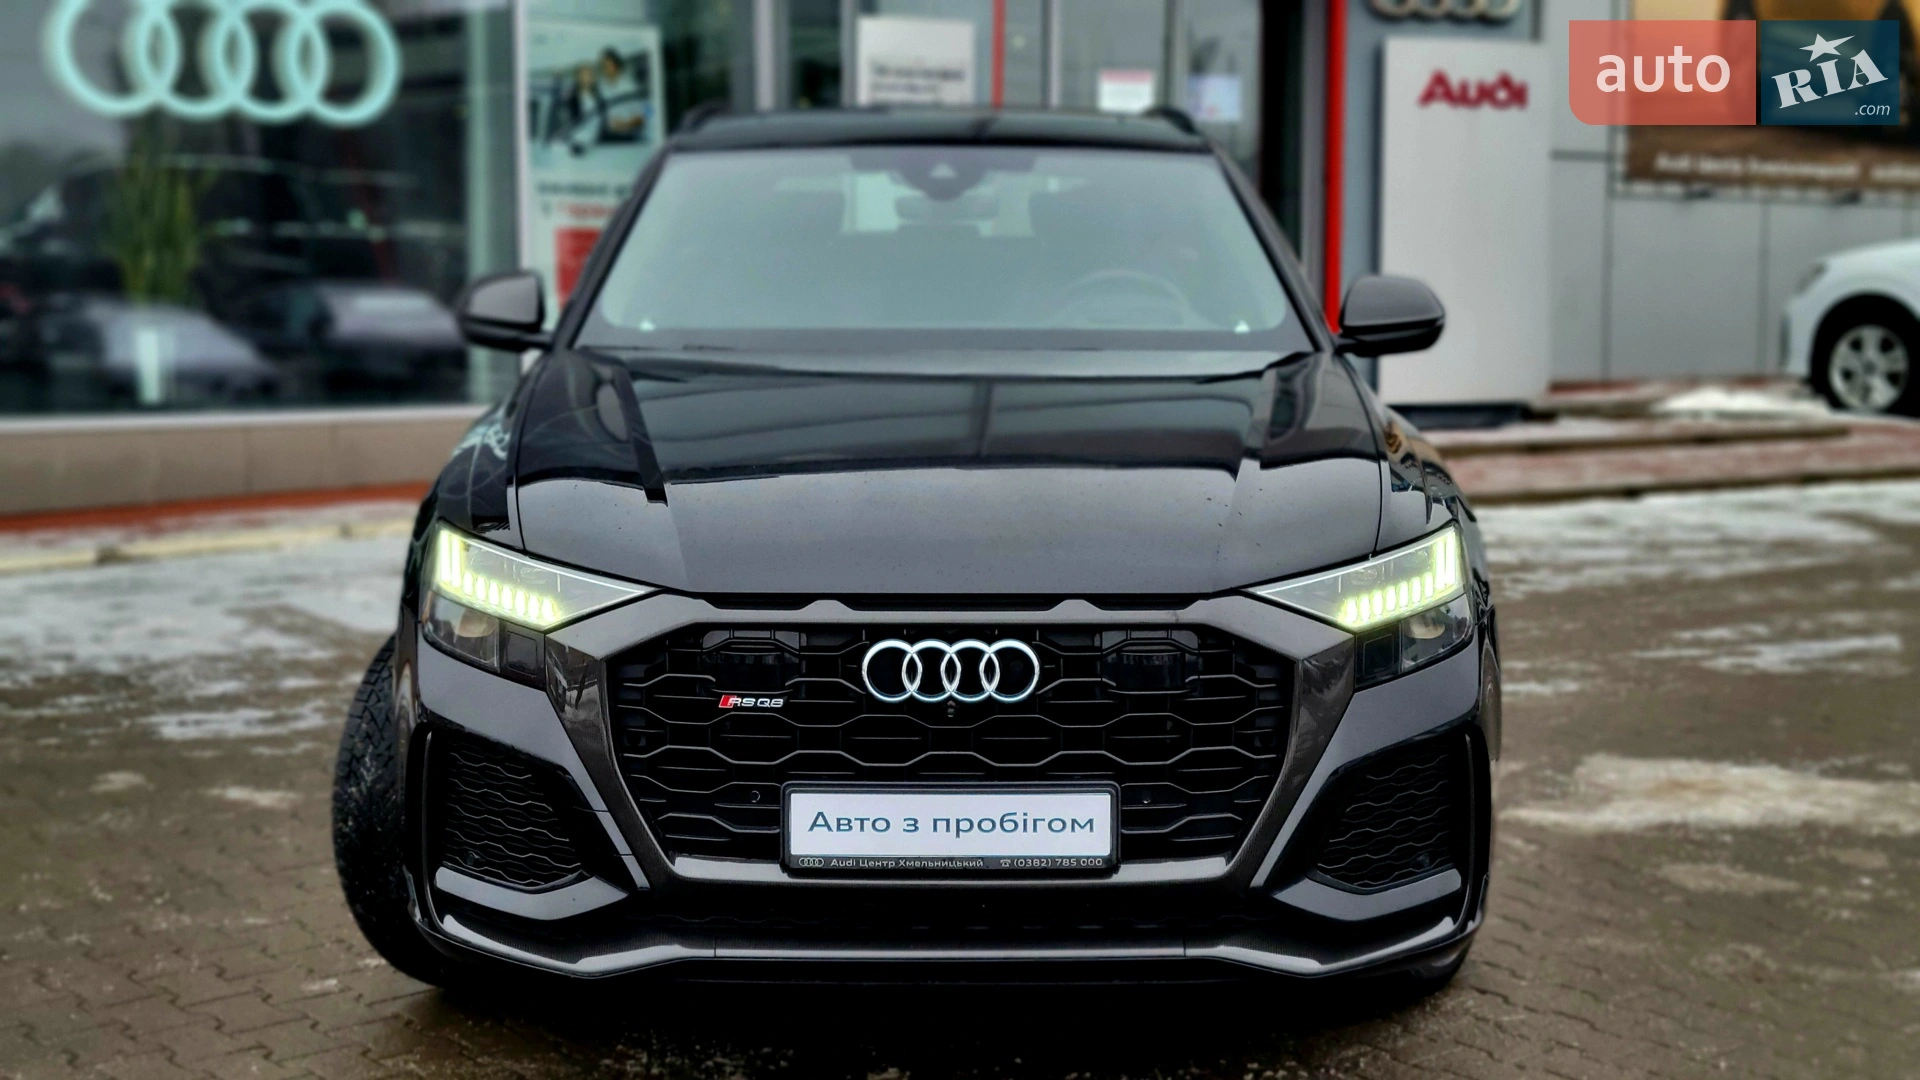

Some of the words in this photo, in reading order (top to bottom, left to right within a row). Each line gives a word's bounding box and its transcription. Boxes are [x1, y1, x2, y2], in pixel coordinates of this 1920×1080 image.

[1418, 68, 1529, 109] Audi
[808, 811, 891, 832] Авто
[902, 816, 920, 833] з
[932, 812, 1094, 838] пробігом
[830, 858, 856, 867] Audi
[859, 858, 895, 868] Центр
[898, 859, 984, 868] Хмельницький
[1013, 858, 1052, 868] (0382)
[1055, 858, 1077, 867] 785
[1080, 858, 1103, 867] 000
